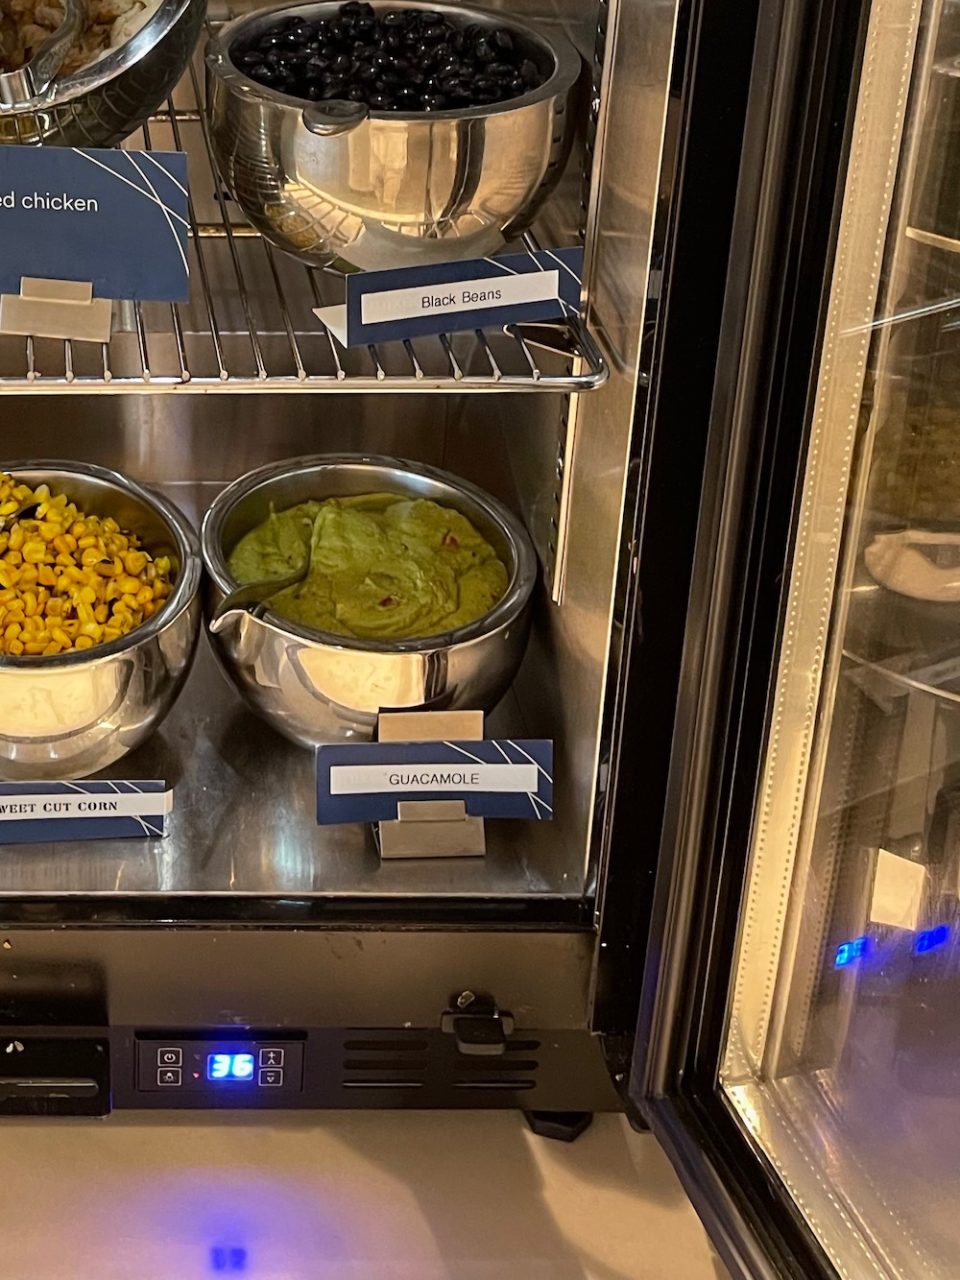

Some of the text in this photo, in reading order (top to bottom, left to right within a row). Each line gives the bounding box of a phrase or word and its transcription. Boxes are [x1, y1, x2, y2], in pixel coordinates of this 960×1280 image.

[21, 192, 99, 213] chicken
[421, 289, 502, 309] Black Beans
[388, 772, 480, 786] GUACAMOLE
[43, 802, 72, 813] CUT
[77, 800, 119, 812] CORN
[211, 1053, 253, 1077] 36
